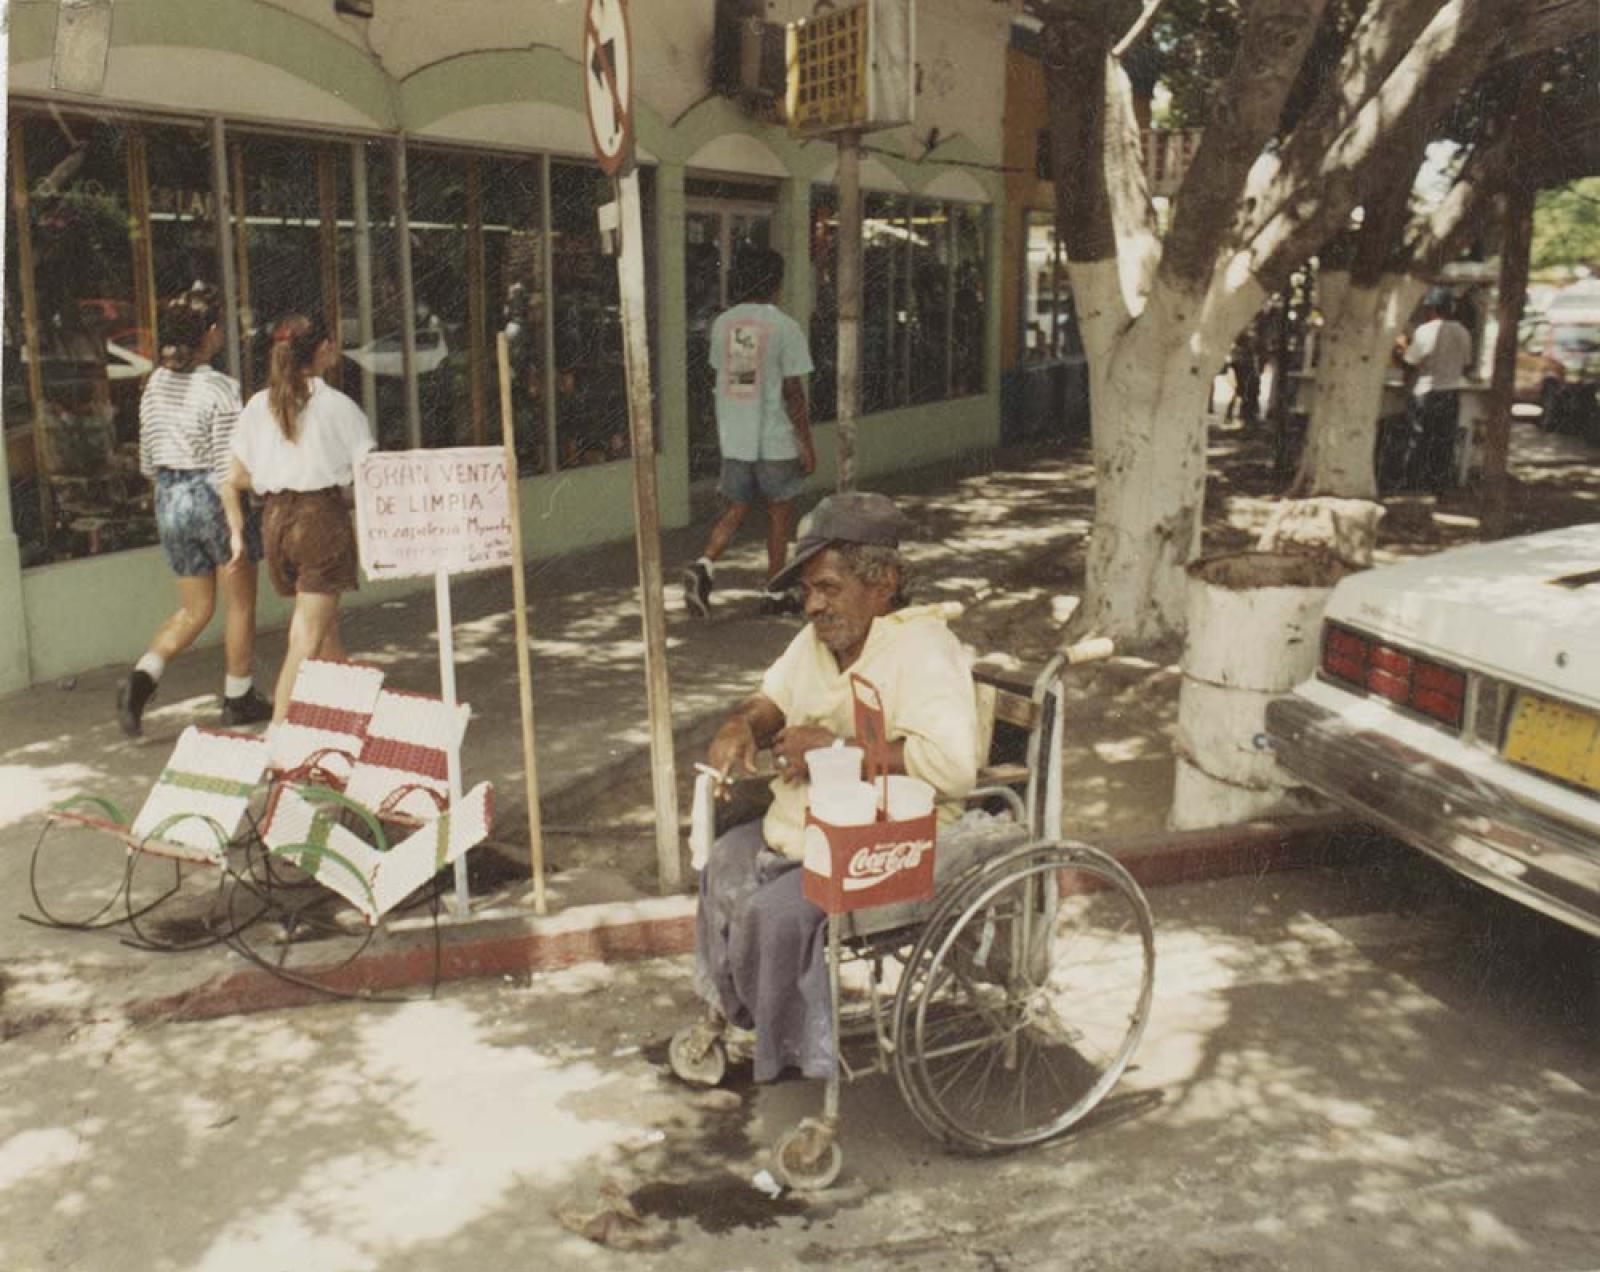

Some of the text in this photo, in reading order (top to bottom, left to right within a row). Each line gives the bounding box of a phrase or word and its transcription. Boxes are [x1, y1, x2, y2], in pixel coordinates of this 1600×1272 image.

[364, 463, 507, 490] GRAN VENTA
[375, 492, 484, 515] DE LIMPIA
